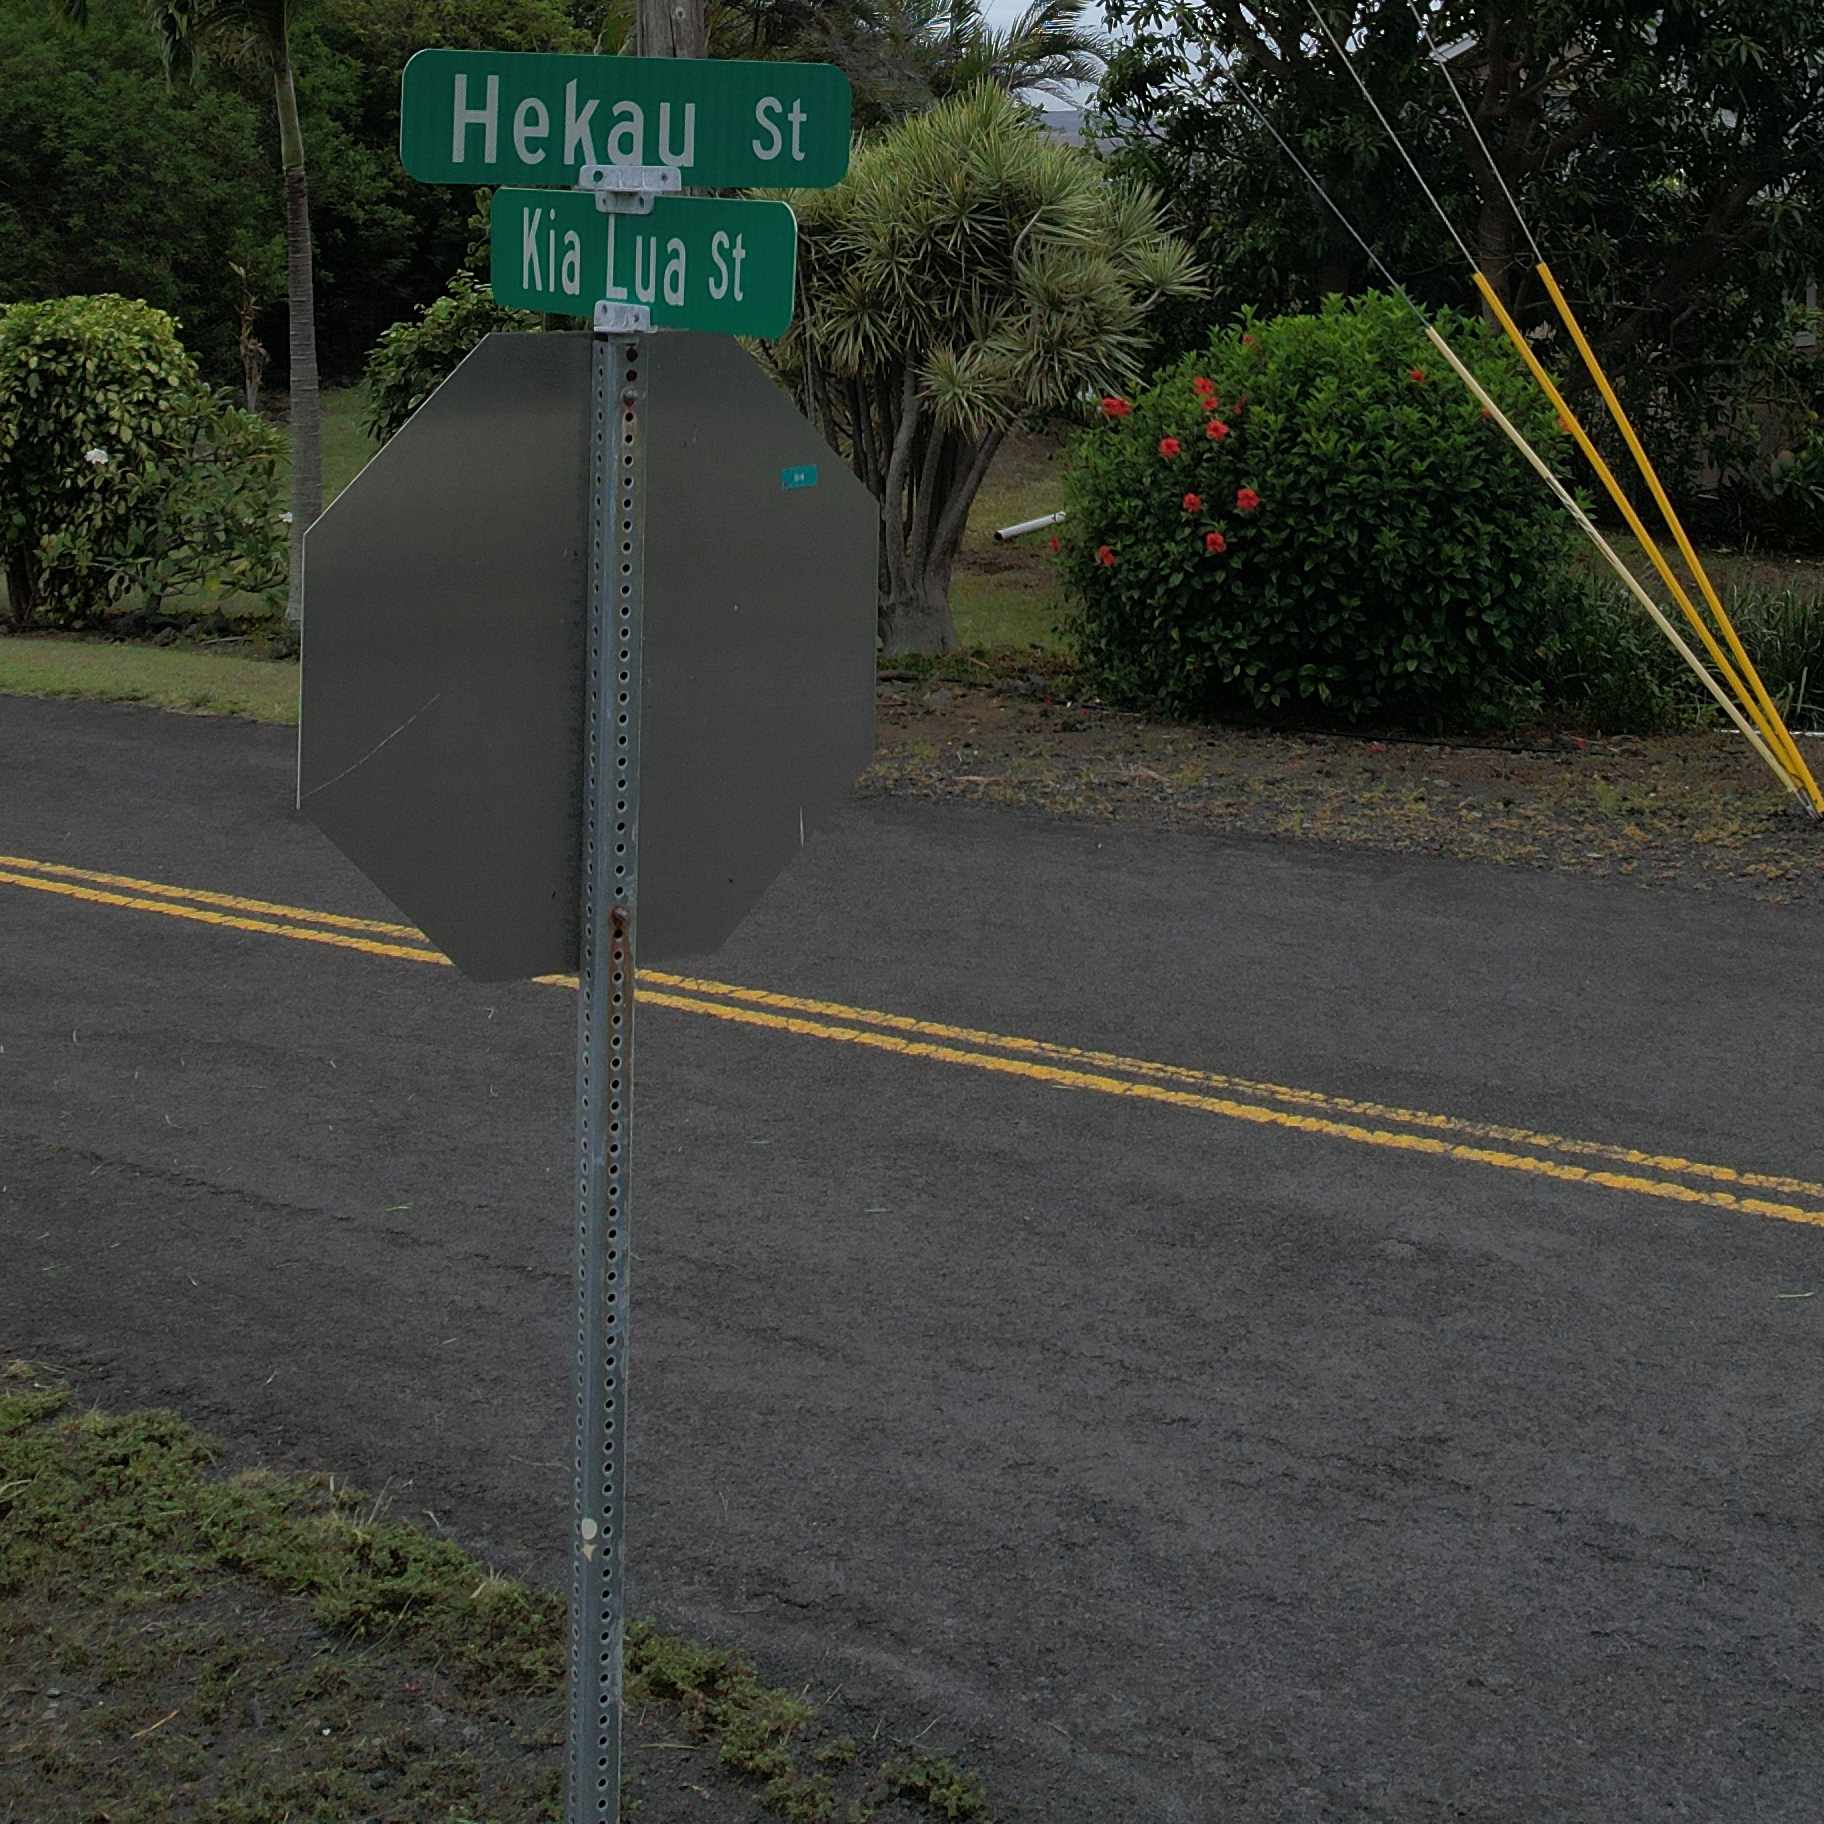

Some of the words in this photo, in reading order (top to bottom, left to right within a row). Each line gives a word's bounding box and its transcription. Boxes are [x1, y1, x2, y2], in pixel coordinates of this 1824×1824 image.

[452, 73, 696, 167] Hekau
[752, 96, 807, 161] St
[522, 207, 581, 296] Kia
[606, 213, 686, 306] Lua
[708, 230, 746, 302] St
